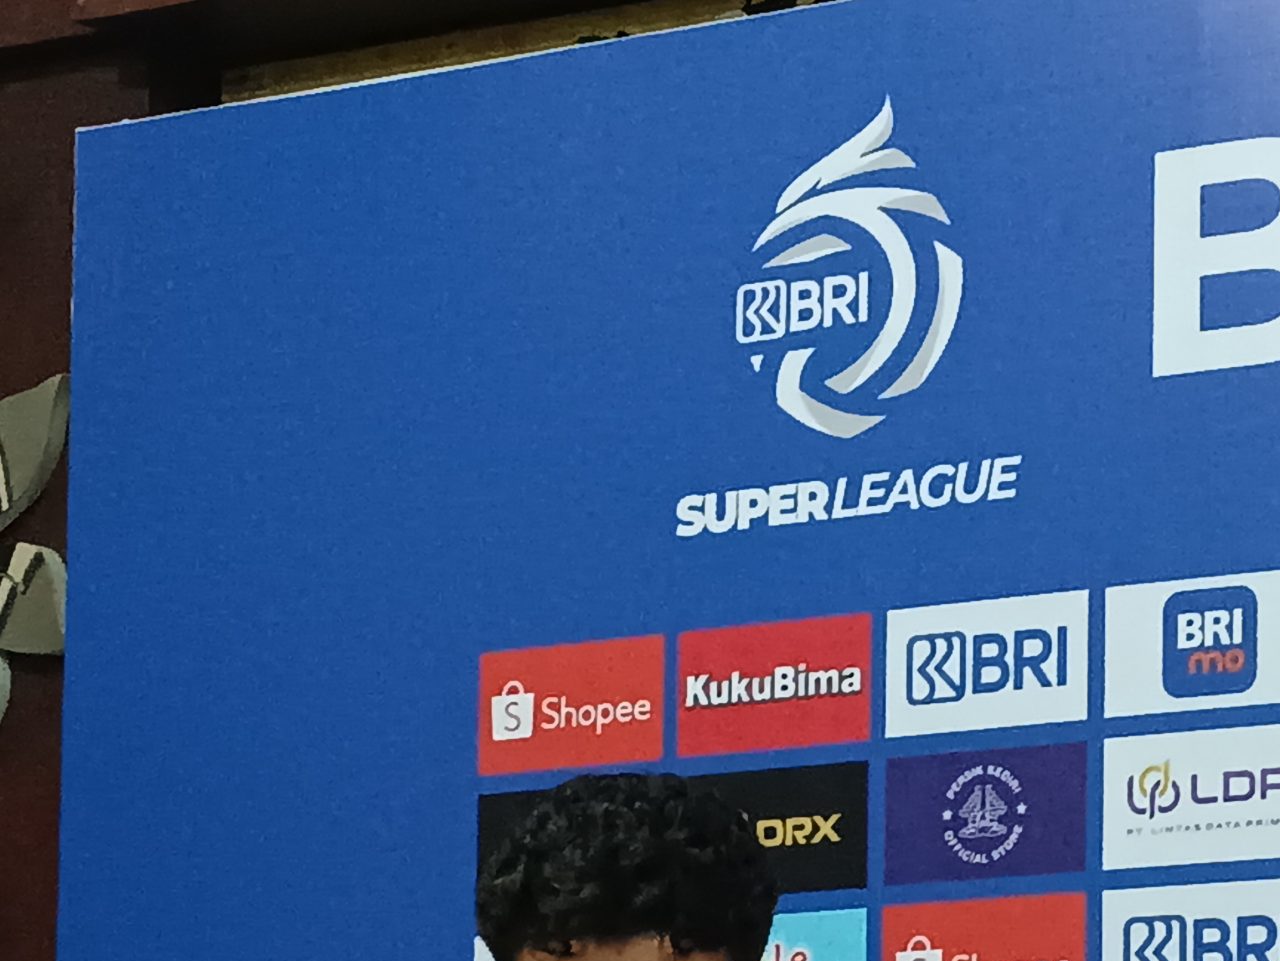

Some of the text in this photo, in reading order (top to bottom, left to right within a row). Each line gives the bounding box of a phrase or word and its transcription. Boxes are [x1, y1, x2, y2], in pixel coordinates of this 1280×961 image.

[790, 271, 869, 333] BRI
[1177, 608, 1243, 650] BRI
[972, 626, 1067, 694] BRI
[1187, 648, 1246, 675] mo
[684, 663, 862, 708] KukuBima
[540, 696, 651, 735] Shopee
